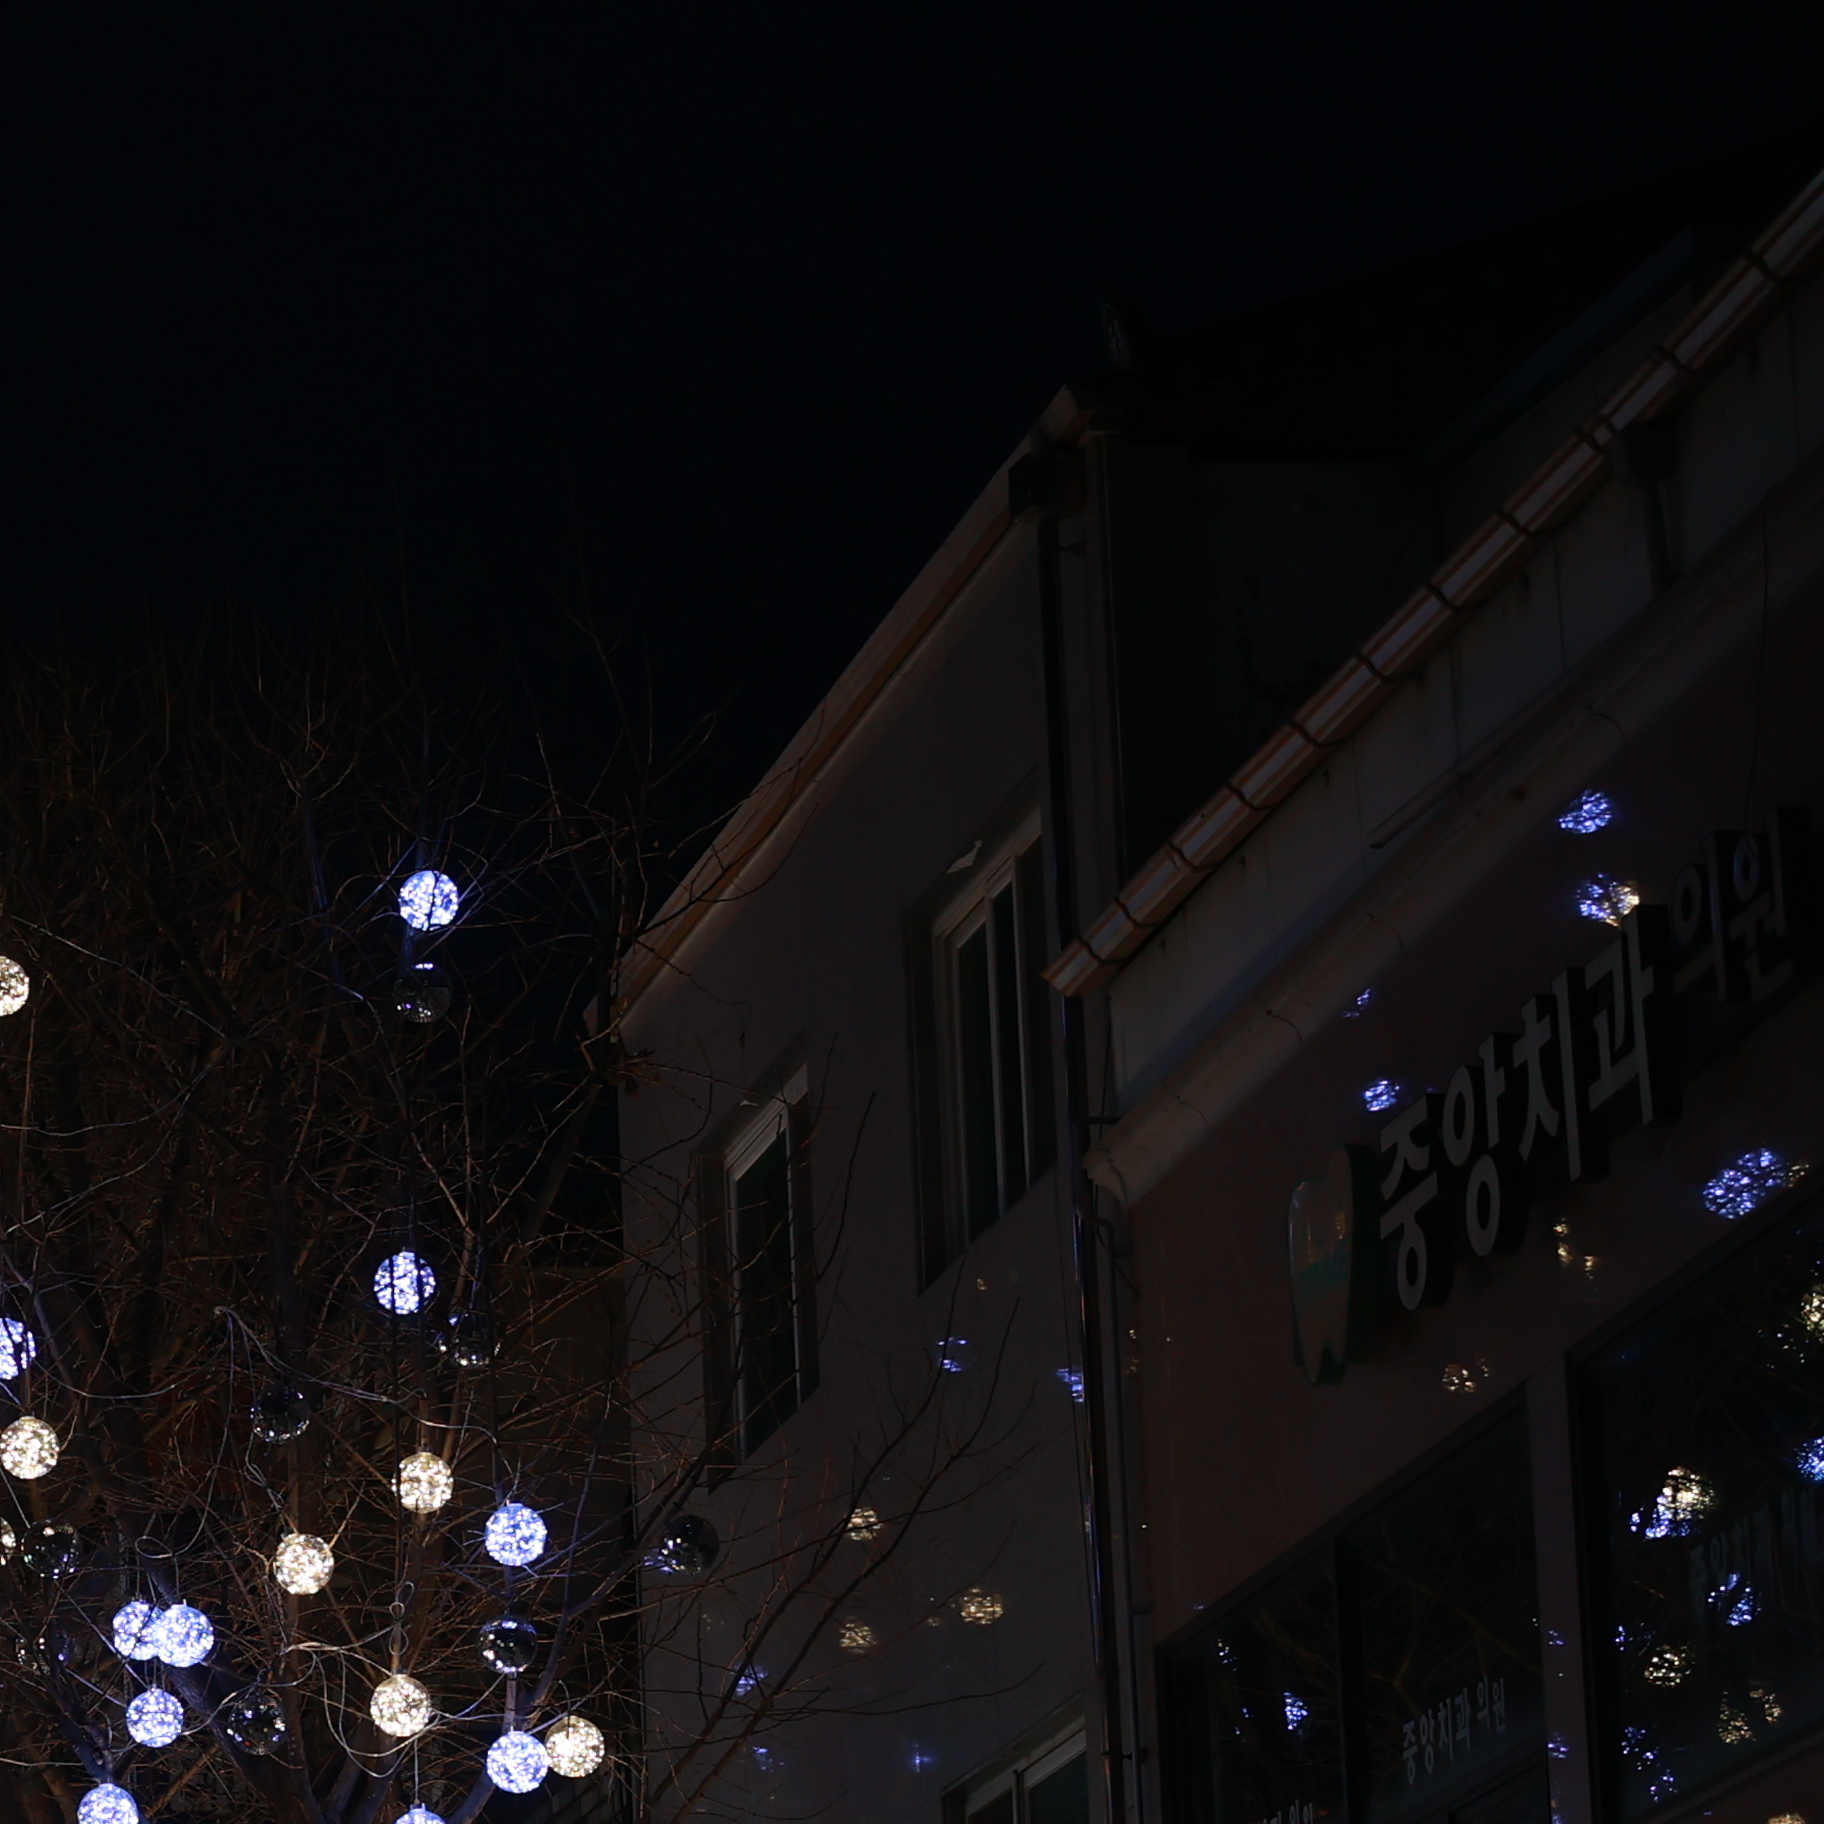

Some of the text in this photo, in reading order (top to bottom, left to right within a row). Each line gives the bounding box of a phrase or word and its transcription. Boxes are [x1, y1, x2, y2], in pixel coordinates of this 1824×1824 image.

[1380, 905, 1662, 1311] 중앙치과
[1401, 1675, 1506, 1785] 중앙치과 의원
